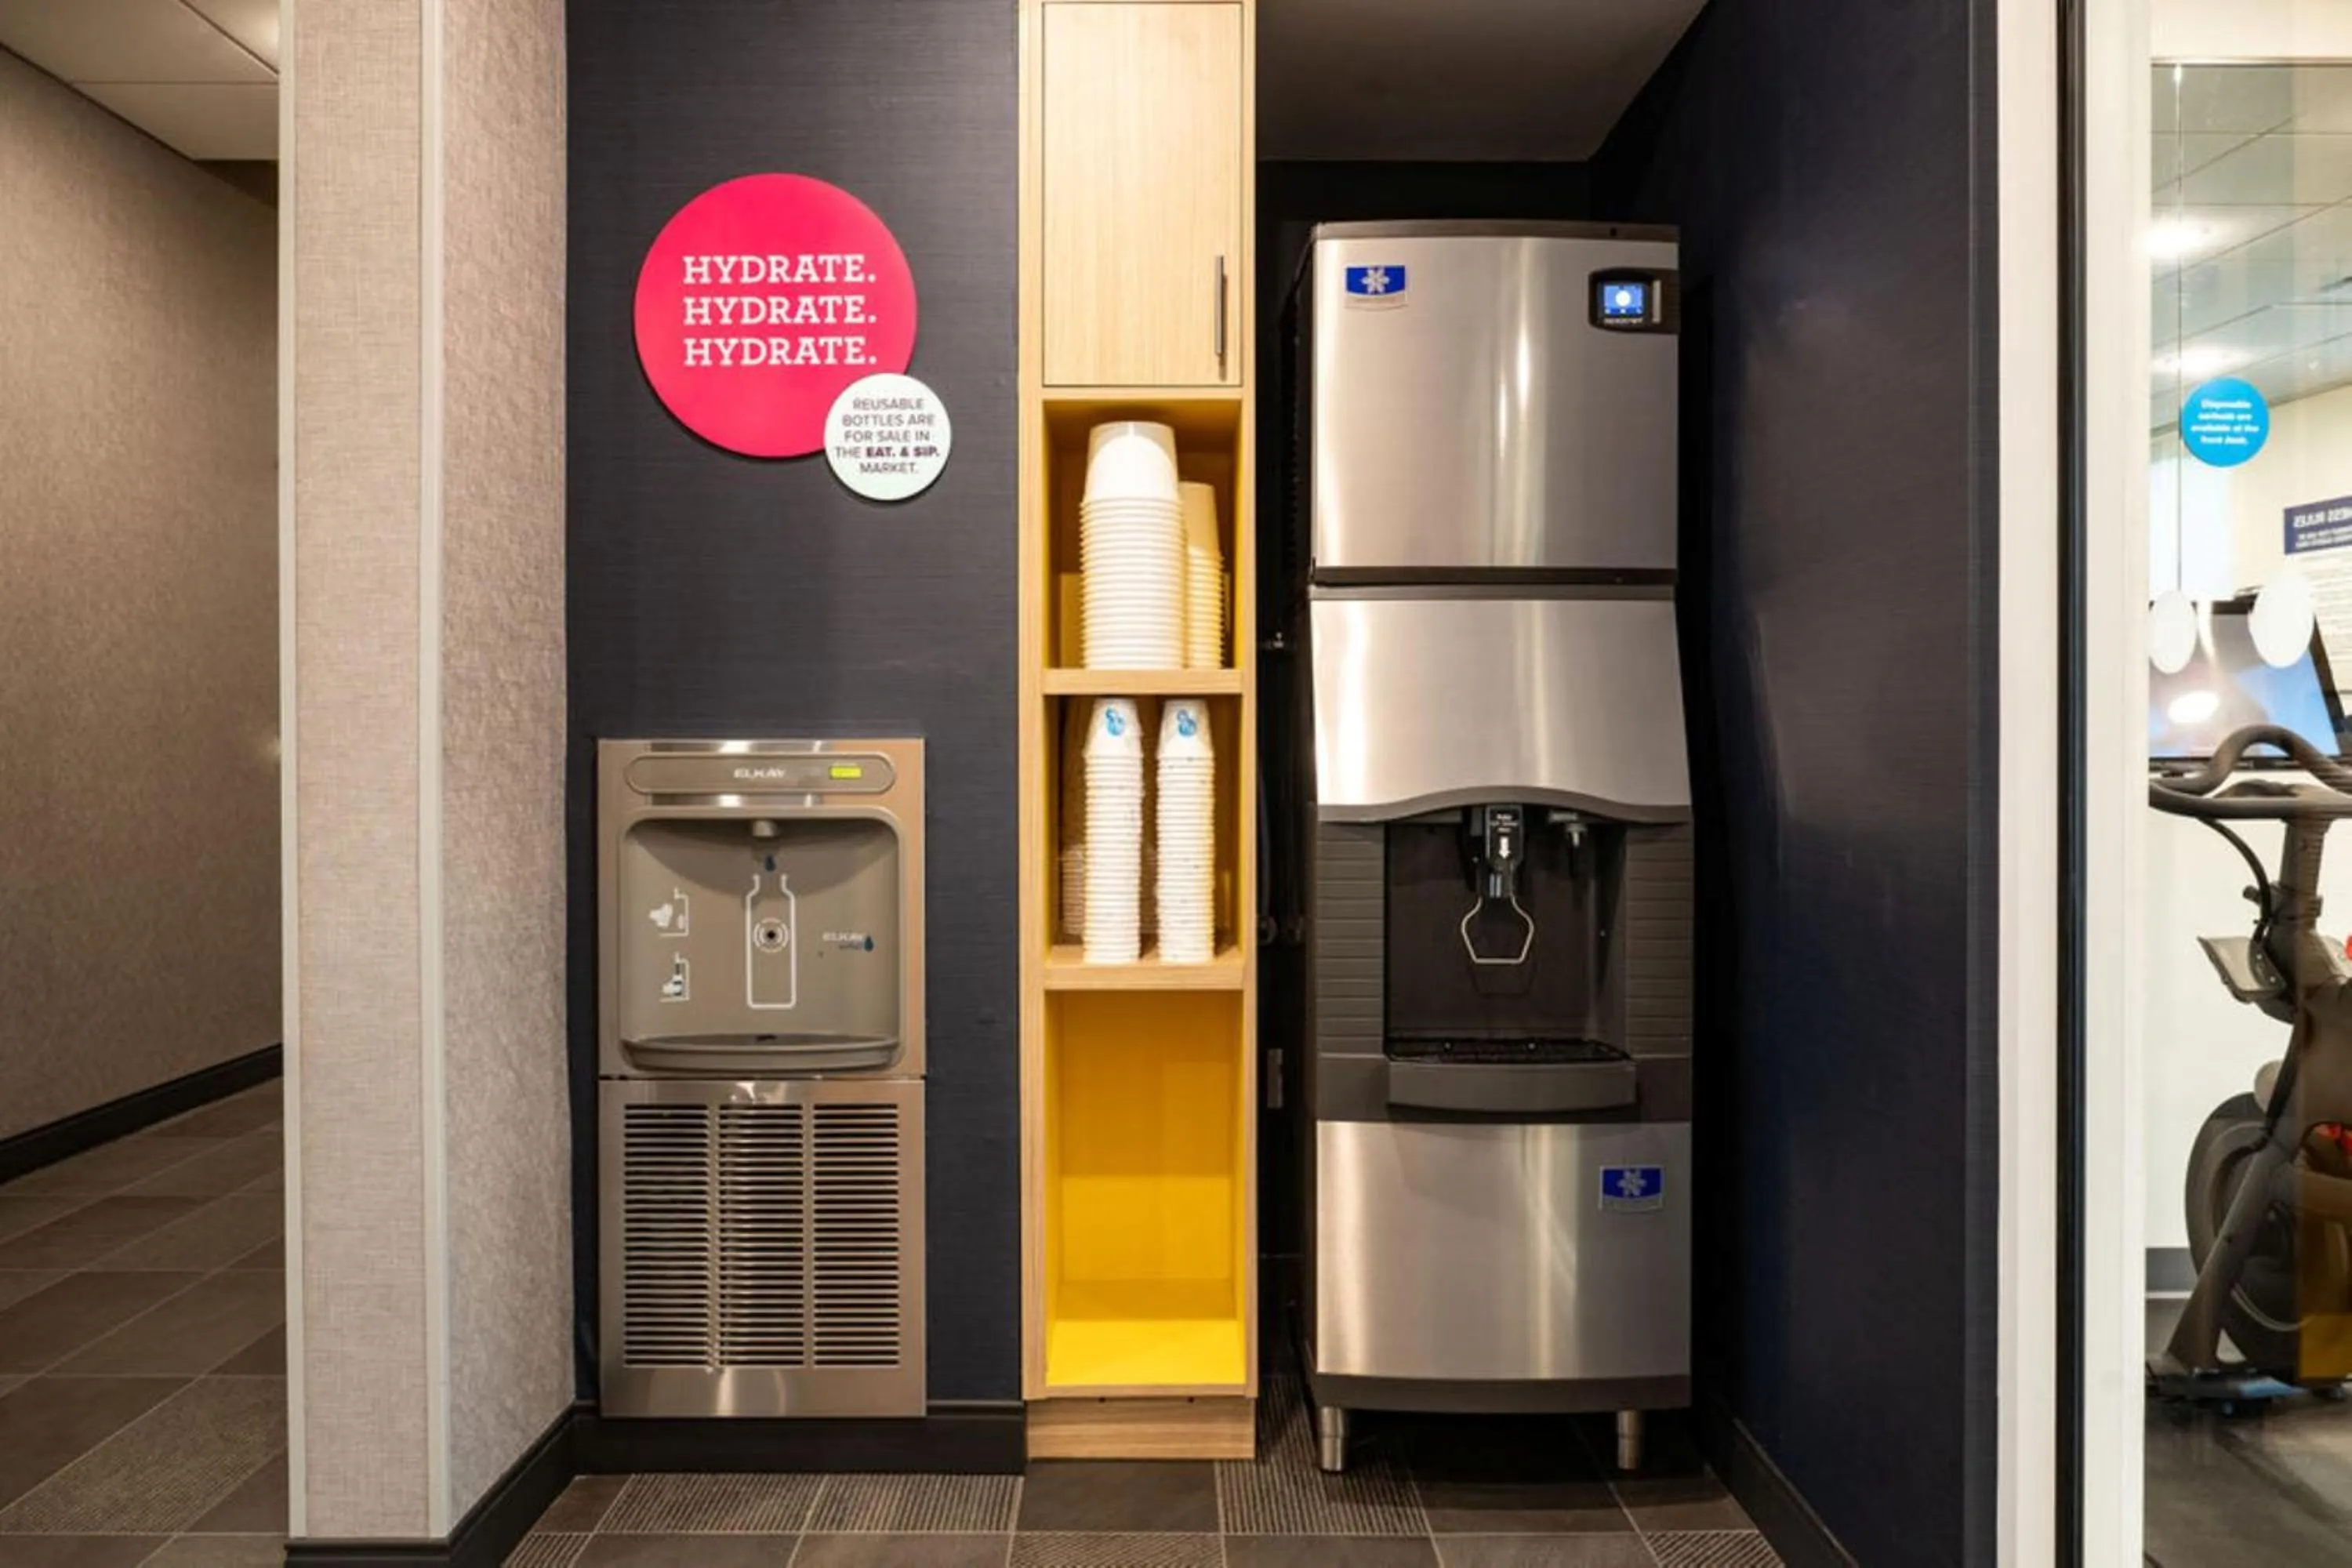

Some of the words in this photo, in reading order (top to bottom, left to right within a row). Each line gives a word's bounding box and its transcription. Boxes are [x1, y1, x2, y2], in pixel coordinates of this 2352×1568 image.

[683, 254, 877, 284] HYDRATE.
[683, 295, 877, 325] HYDRATE.
[684, 336, 877, 366] HYDRATE.
[852, 398, 924, 410] REUSABLE
[842, 414, 904, 426] BOTTLES
[907, 414, 935, 425] ARE
[844, 430, 873, 441] FOR
[877, 430, 910, 441] SALE
[915, 430, 930, 441] IN
[836, 447, 861, 458] THE
[866, 446, 895, 457] EAT.
[900, 447, 909, 457] &
[913, 446, 940, 457] SIP.
[860, 463, 918, 474] MARKET.
[734, 768, 785, 779] ELKAY
